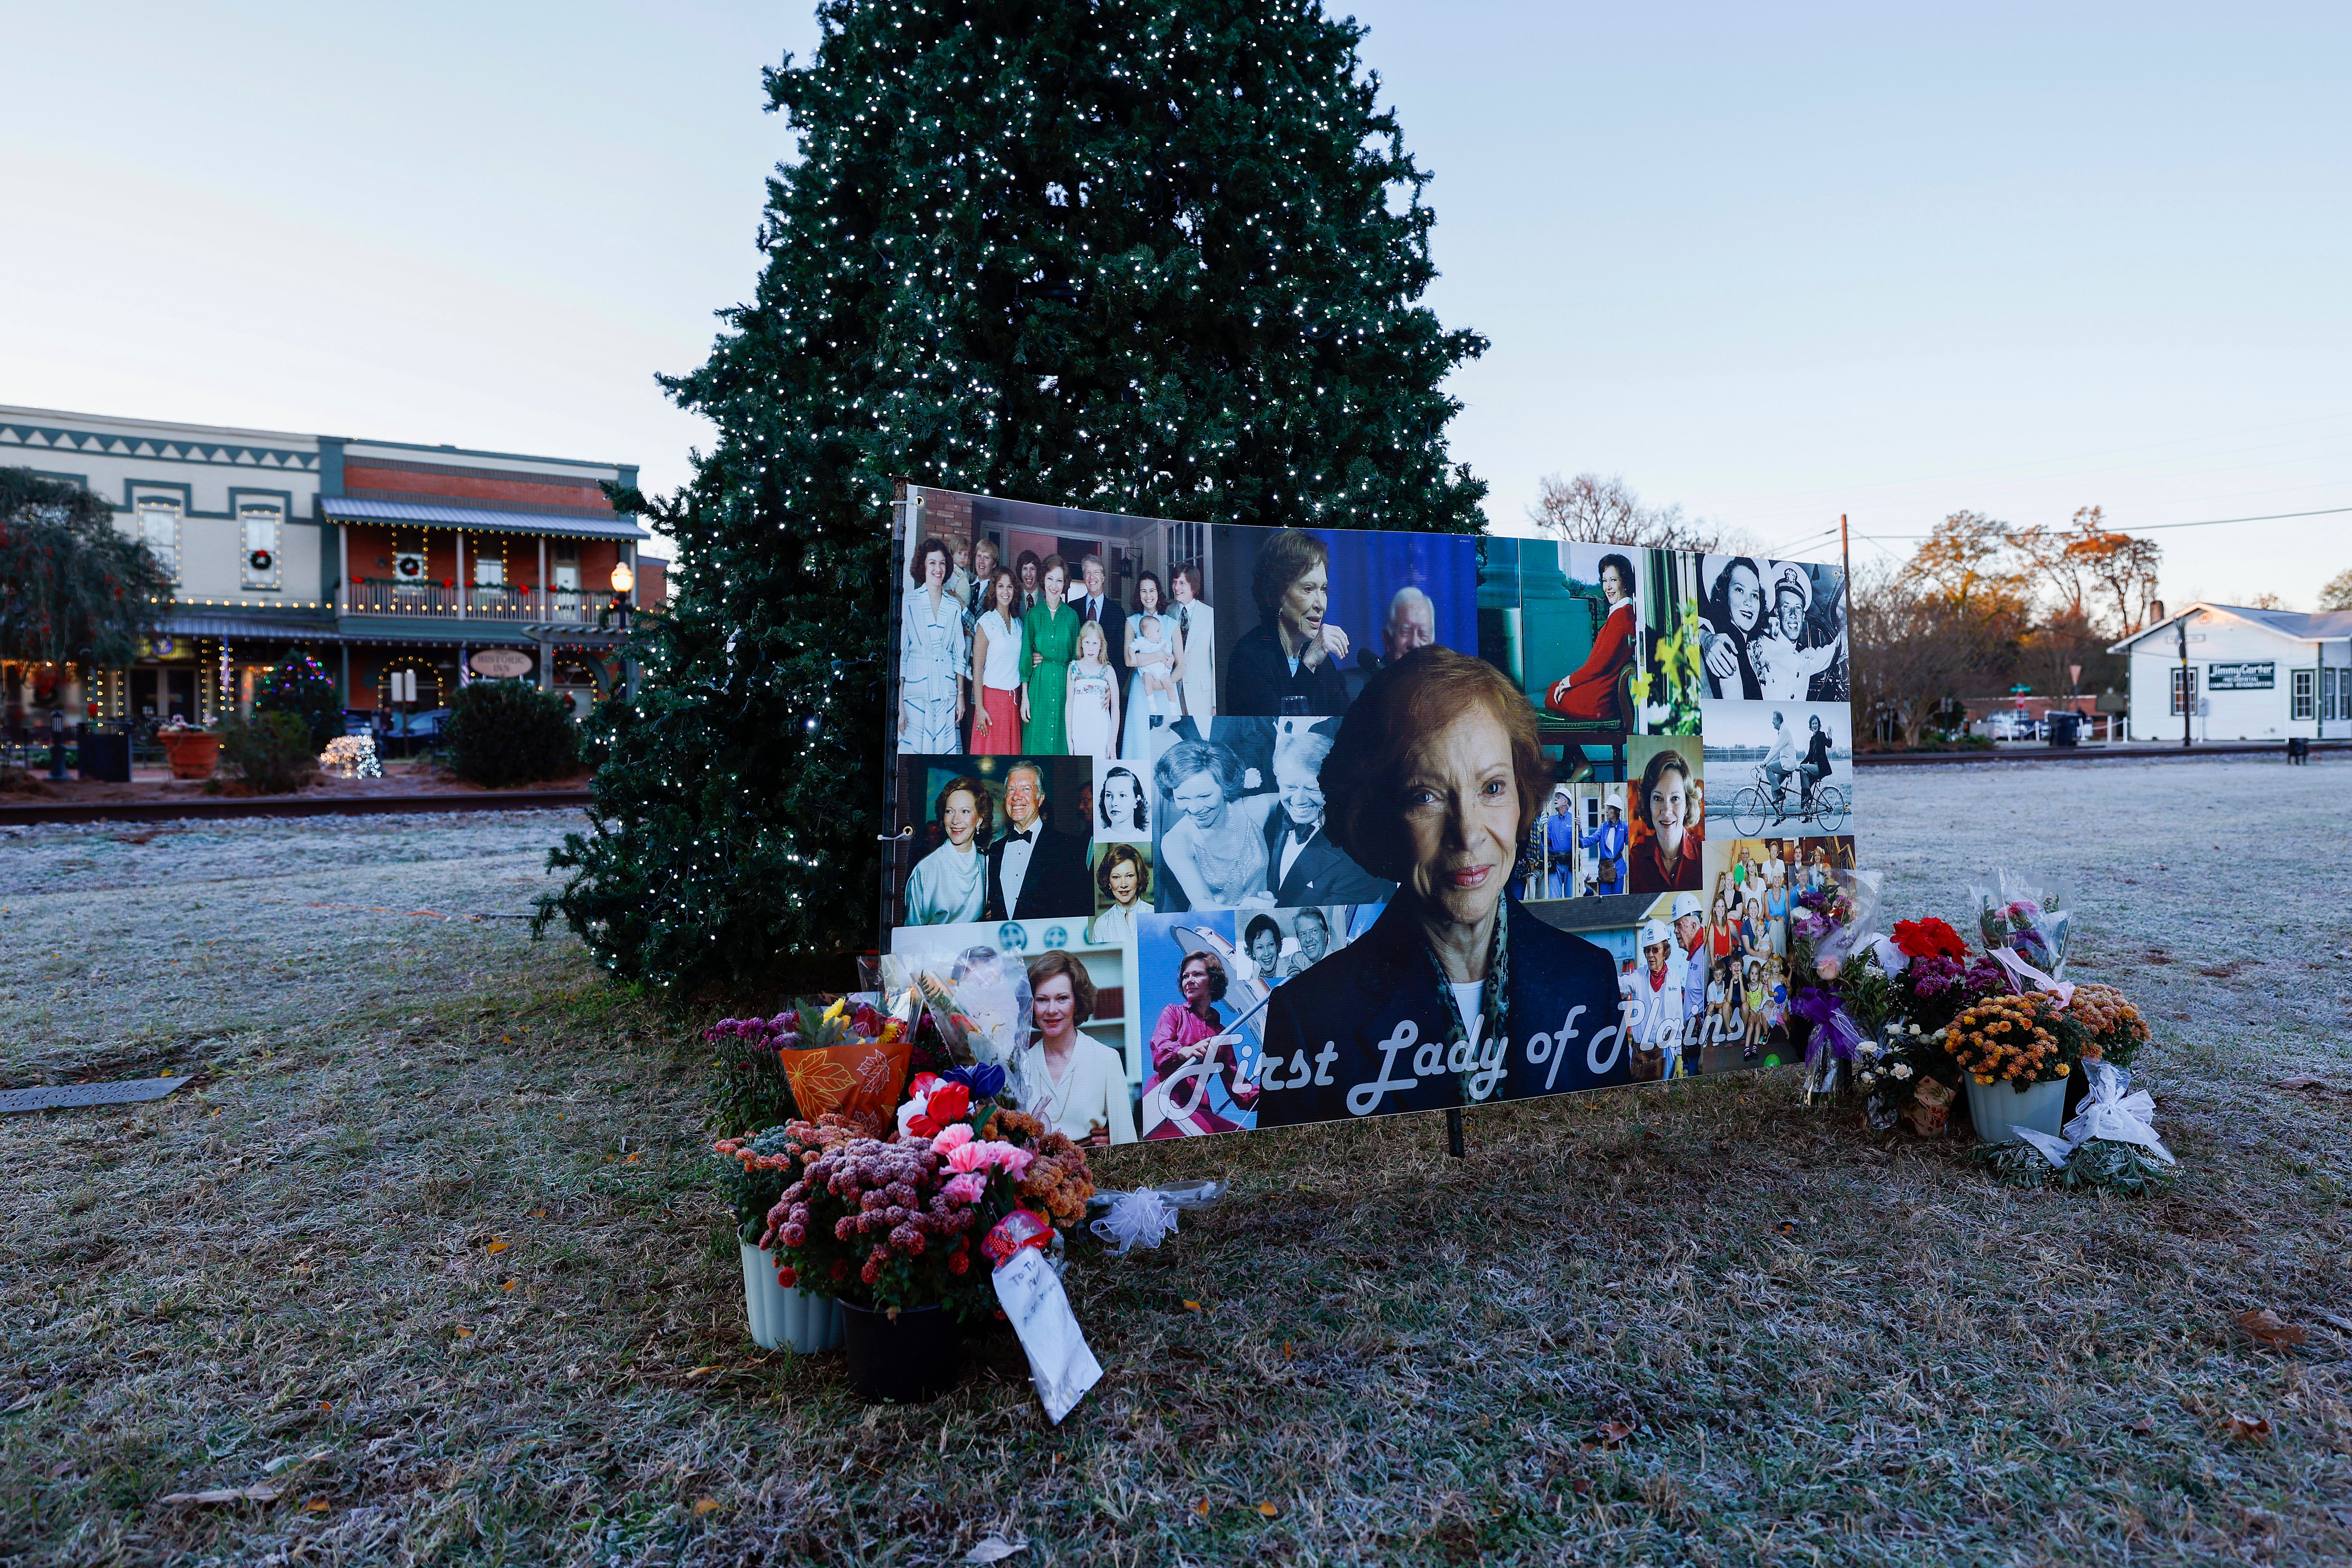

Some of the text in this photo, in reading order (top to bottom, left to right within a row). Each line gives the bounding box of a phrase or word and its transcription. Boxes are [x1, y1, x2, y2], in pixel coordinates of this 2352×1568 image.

[478, 655, 524, 664] HISTORIC
[2209, 663, 2274, 677] Jimmy Carter
[1158, 997, 1745, 1121] First Lady of Plains
